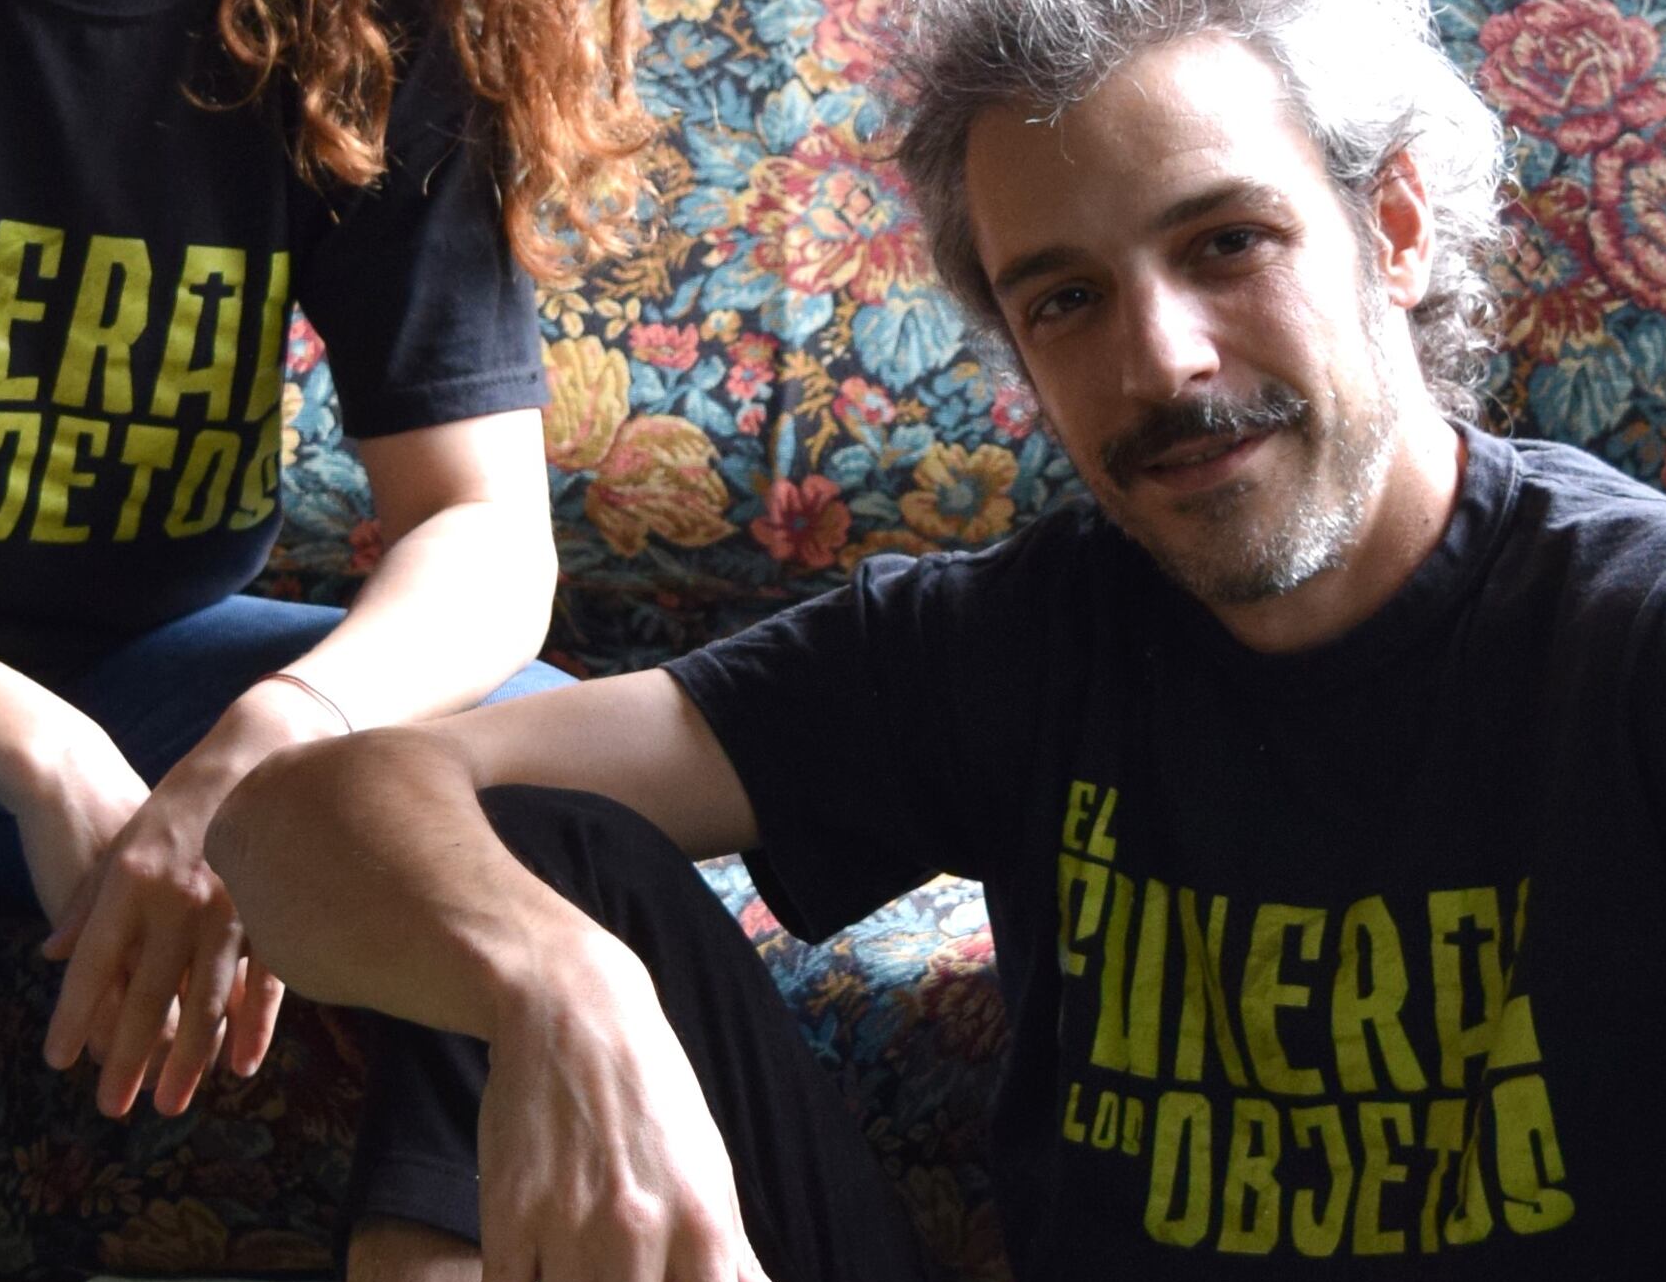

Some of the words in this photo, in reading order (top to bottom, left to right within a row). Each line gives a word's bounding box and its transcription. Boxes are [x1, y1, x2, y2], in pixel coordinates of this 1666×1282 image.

[1061, 780, 1119, 862] EL
[1063, 1083, 1145, 1156] LOS
[1143, 1074, 1577, 1259] OBJETOS
